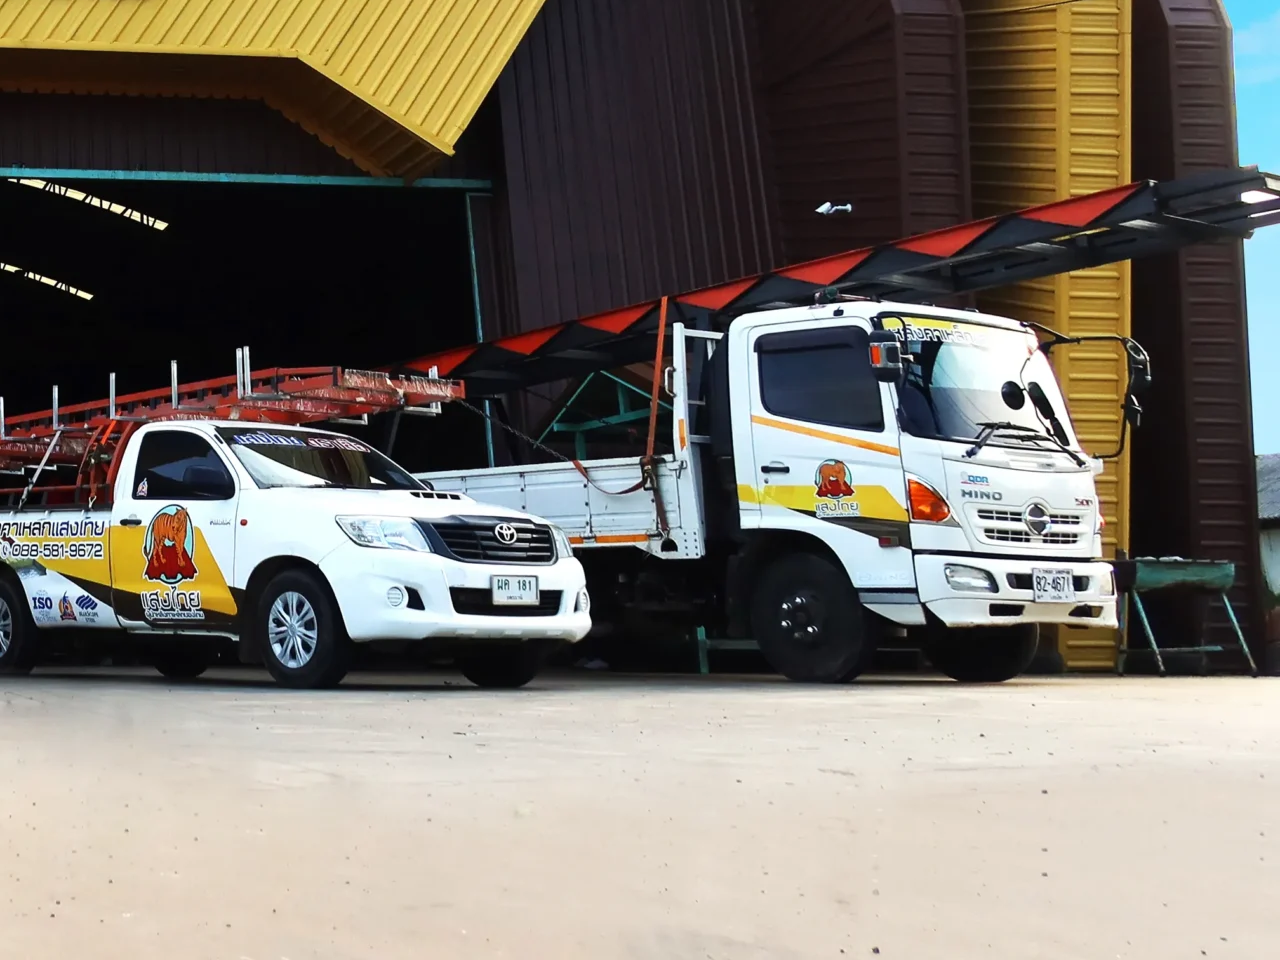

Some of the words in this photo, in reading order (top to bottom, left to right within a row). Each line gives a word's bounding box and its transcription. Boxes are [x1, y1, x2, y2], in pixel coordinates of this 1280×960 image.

[960, 489, 1003, 501] HINO
[815, 499, 859, 512] แสงไทย
[11, 542, 104, 558] 088-581-9672
[517, 579, 532, 591] 181
[31, 596, 53, 610] ISO
[141, 585, 202, 611] แสงไทย
